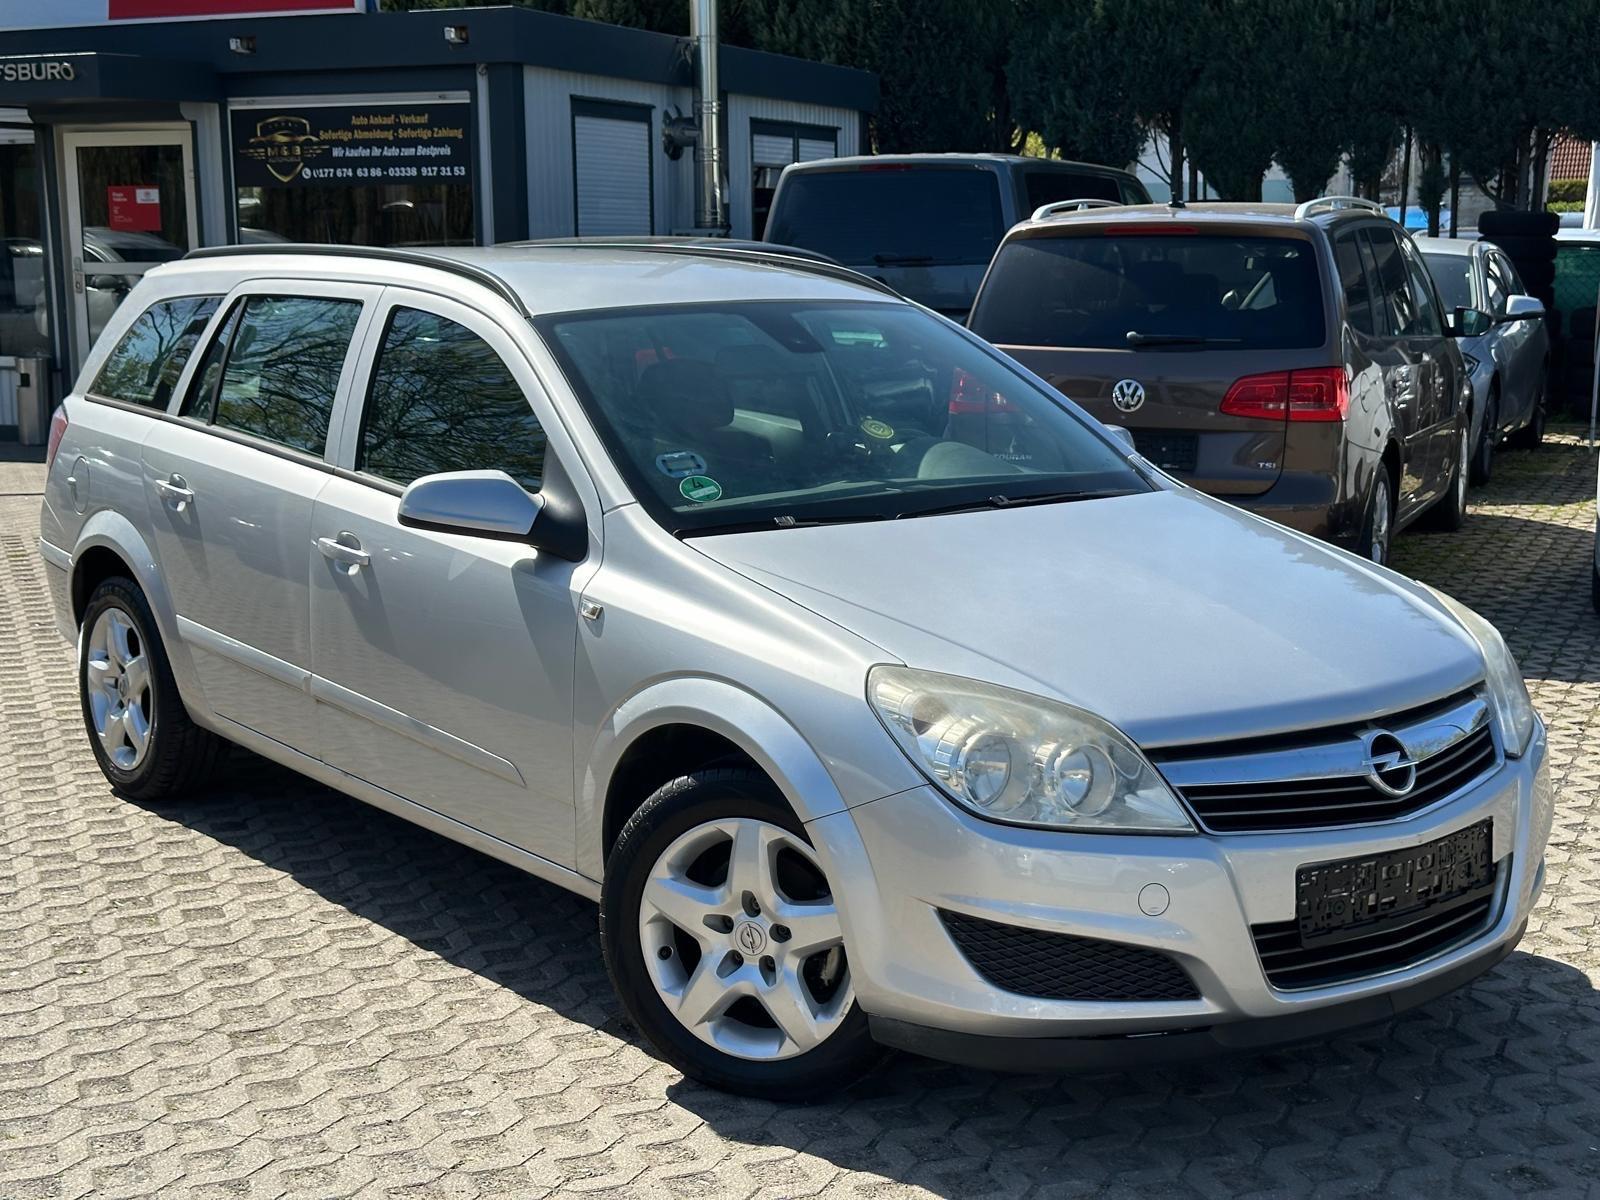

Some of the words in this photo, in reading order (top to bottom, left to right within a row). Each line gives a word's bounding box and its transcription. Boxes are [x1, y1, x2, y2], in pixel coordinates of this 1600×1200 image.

[0, 62, 75, 81] SBURO
[351, 115, 368, 125] Auto
[369, 114, 395, 125] Ankauf
[399, 113, 429, 124] Verkauf
[319, 129, 353, 141] Sofortige
[353, 128, 393, 141] Abmeldung
[398, 128, 432, 140] Sofortige
[432, 127, 463, 139] Zahlung
[332, 147, 345, 157] Wir
[345, 146, 370, 157] kaufen
[382, 146, 400, 156] Auto
[400, 147, 415, 156] zum
[416, 144, 452, 158] Bestpreis
[336, 168, 353, 178] 674
[356, 167, 369, 177] 63
[388, 166, 418, 177] 03338
[421, 166, 438, 176] 917
[440, 166, 452, 176] 31
[453, 165, 466, 176] 53
